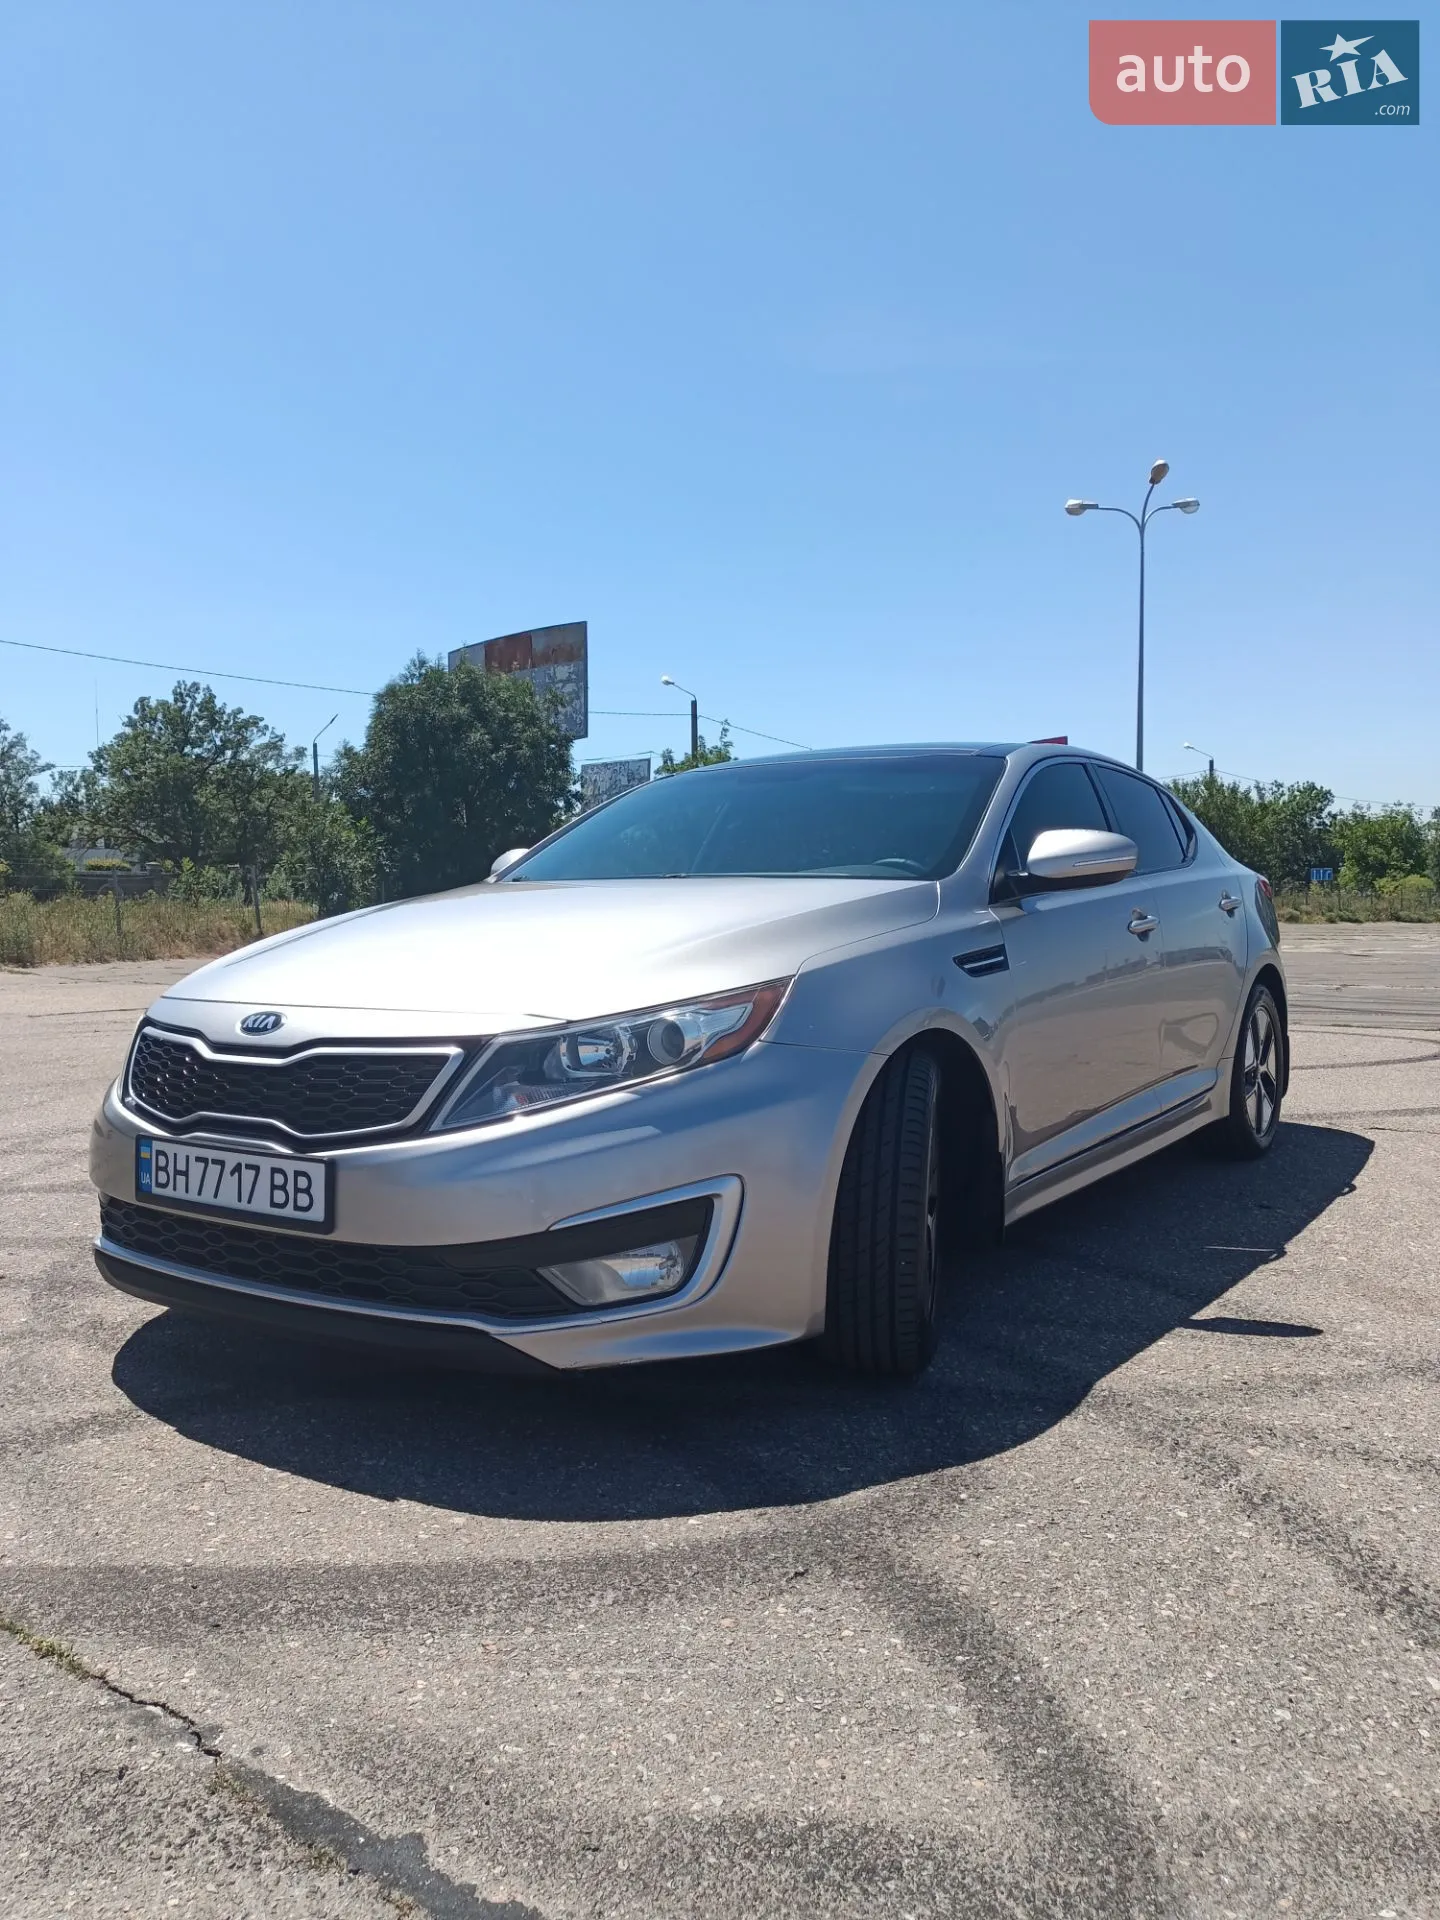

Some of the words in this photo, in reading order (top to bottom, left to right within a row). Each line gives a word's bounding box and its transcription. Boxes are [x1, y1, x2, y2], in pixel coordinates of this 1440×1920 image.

[242, 1014, 276, 1029] KIA
[140, 1172, 151, 1185] UA
[269, 1166, 314, 1213] BB
